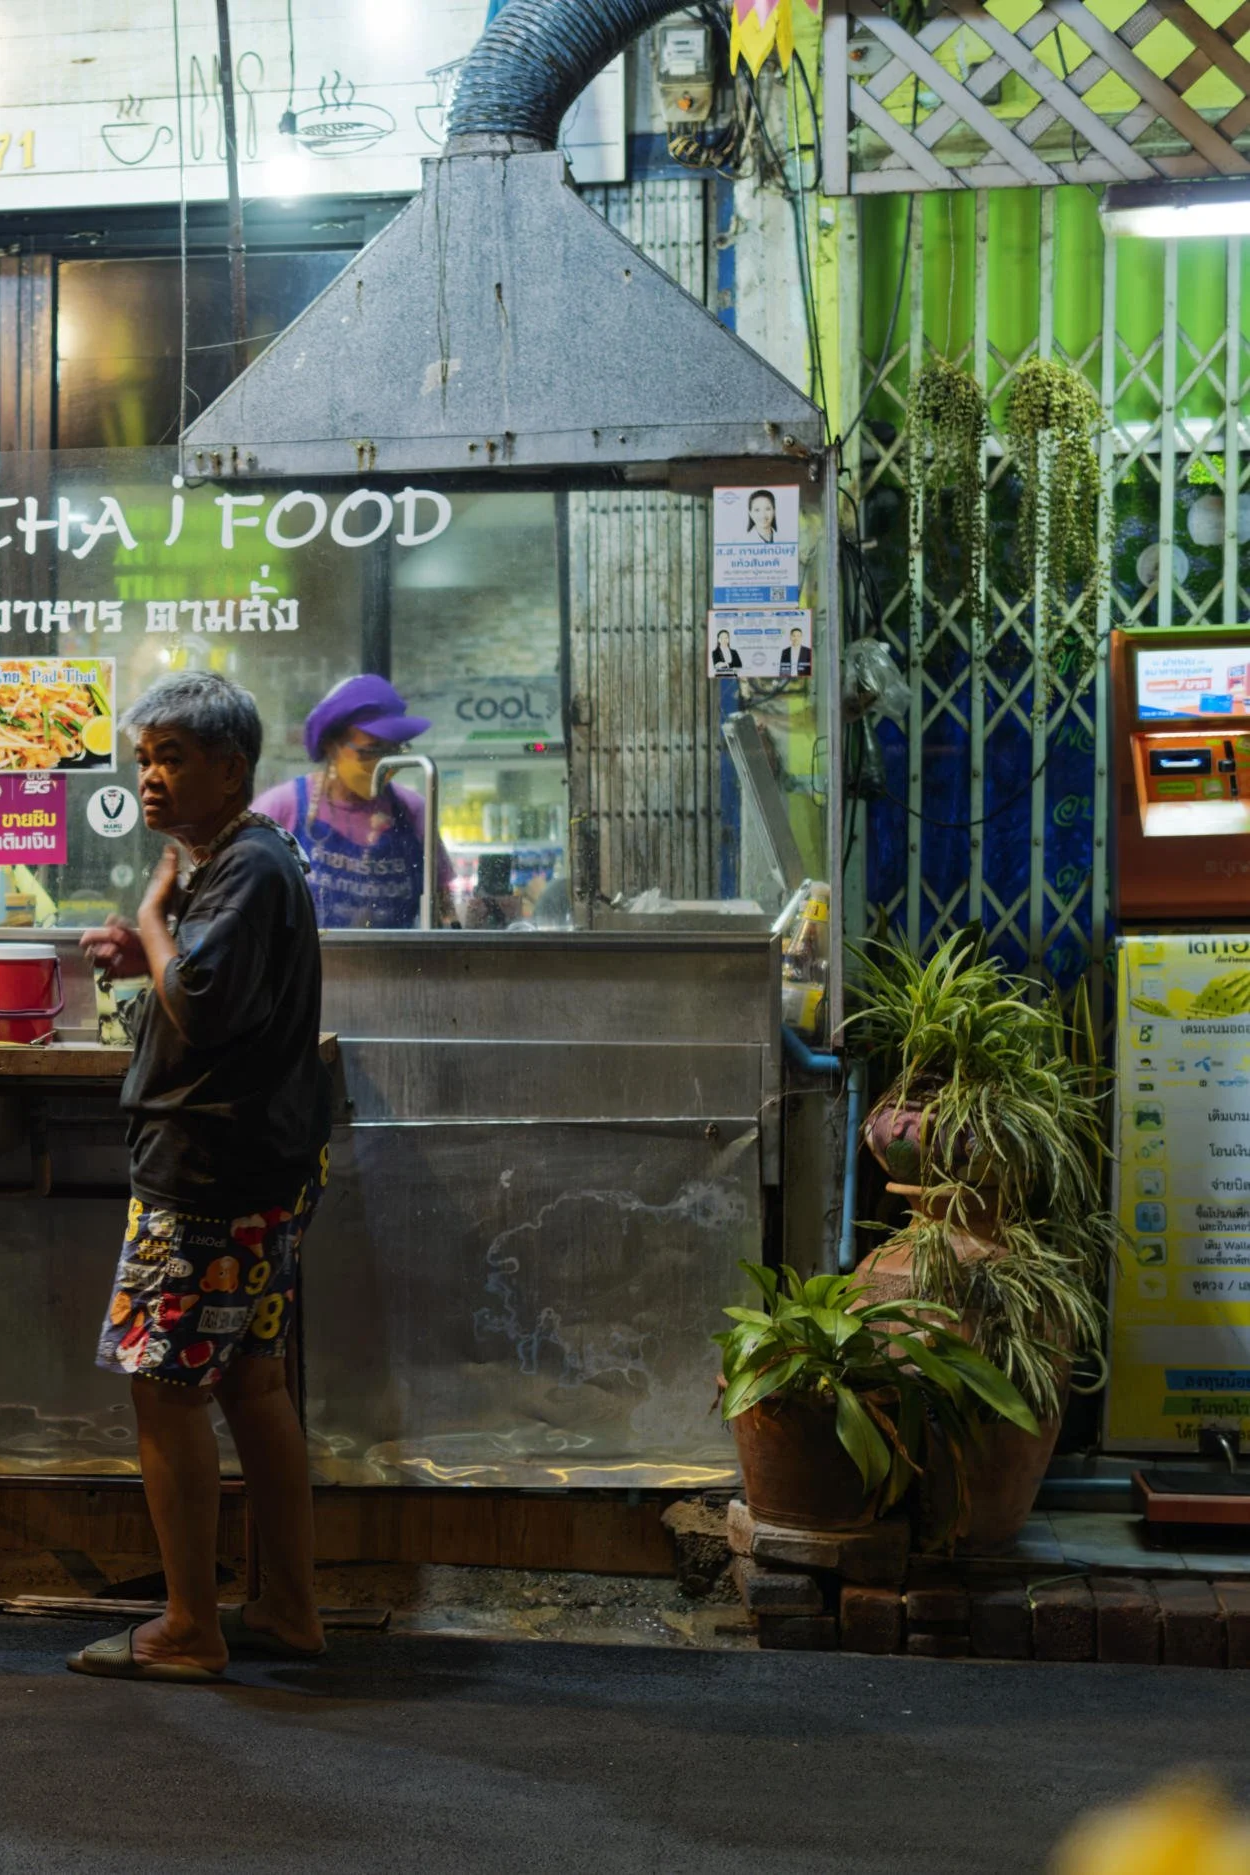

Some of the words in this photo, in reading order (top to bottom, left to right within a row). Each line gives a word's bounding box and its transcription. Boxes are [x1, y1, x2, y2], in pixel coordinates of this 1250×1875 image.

[214, 487, 452, 550] FOOD
[145, 565, 300, 634] ตามสั่ง
[31, 669, 58, 684] Pad
[63, 668, 98, 684] Thai
